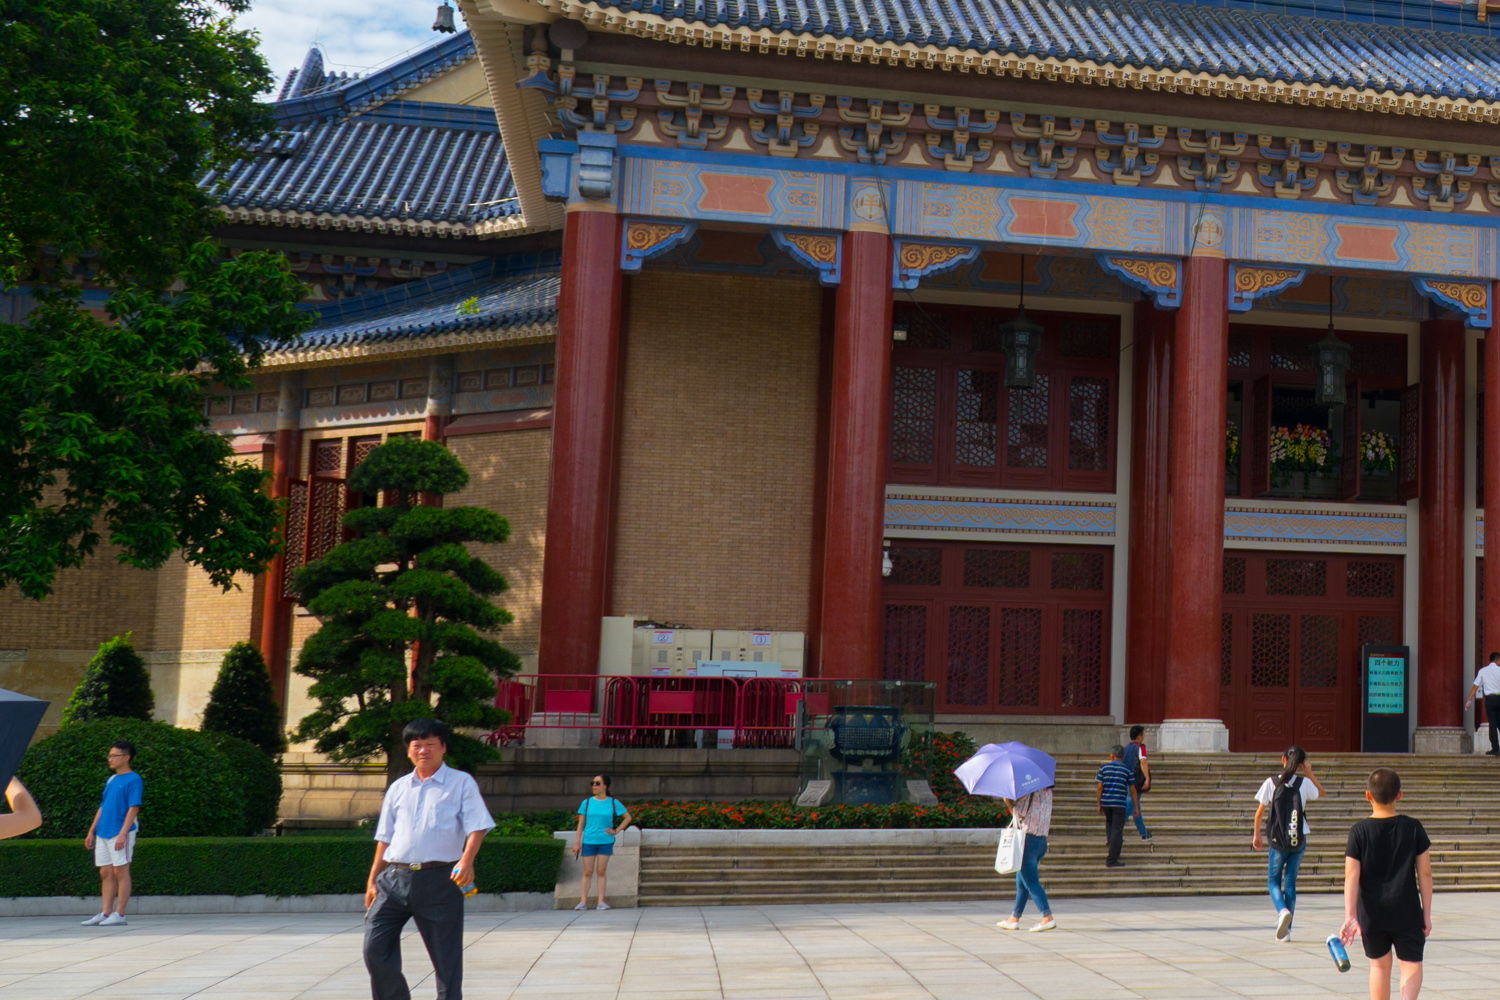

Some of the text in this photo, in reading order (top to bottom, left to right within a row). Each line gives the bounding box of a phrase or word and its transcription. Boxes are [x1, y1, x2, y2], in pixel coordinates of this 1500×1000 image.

[1374, 659, 1400, 667] 四个能力
[1288, 809, 1298, 846] adidas
